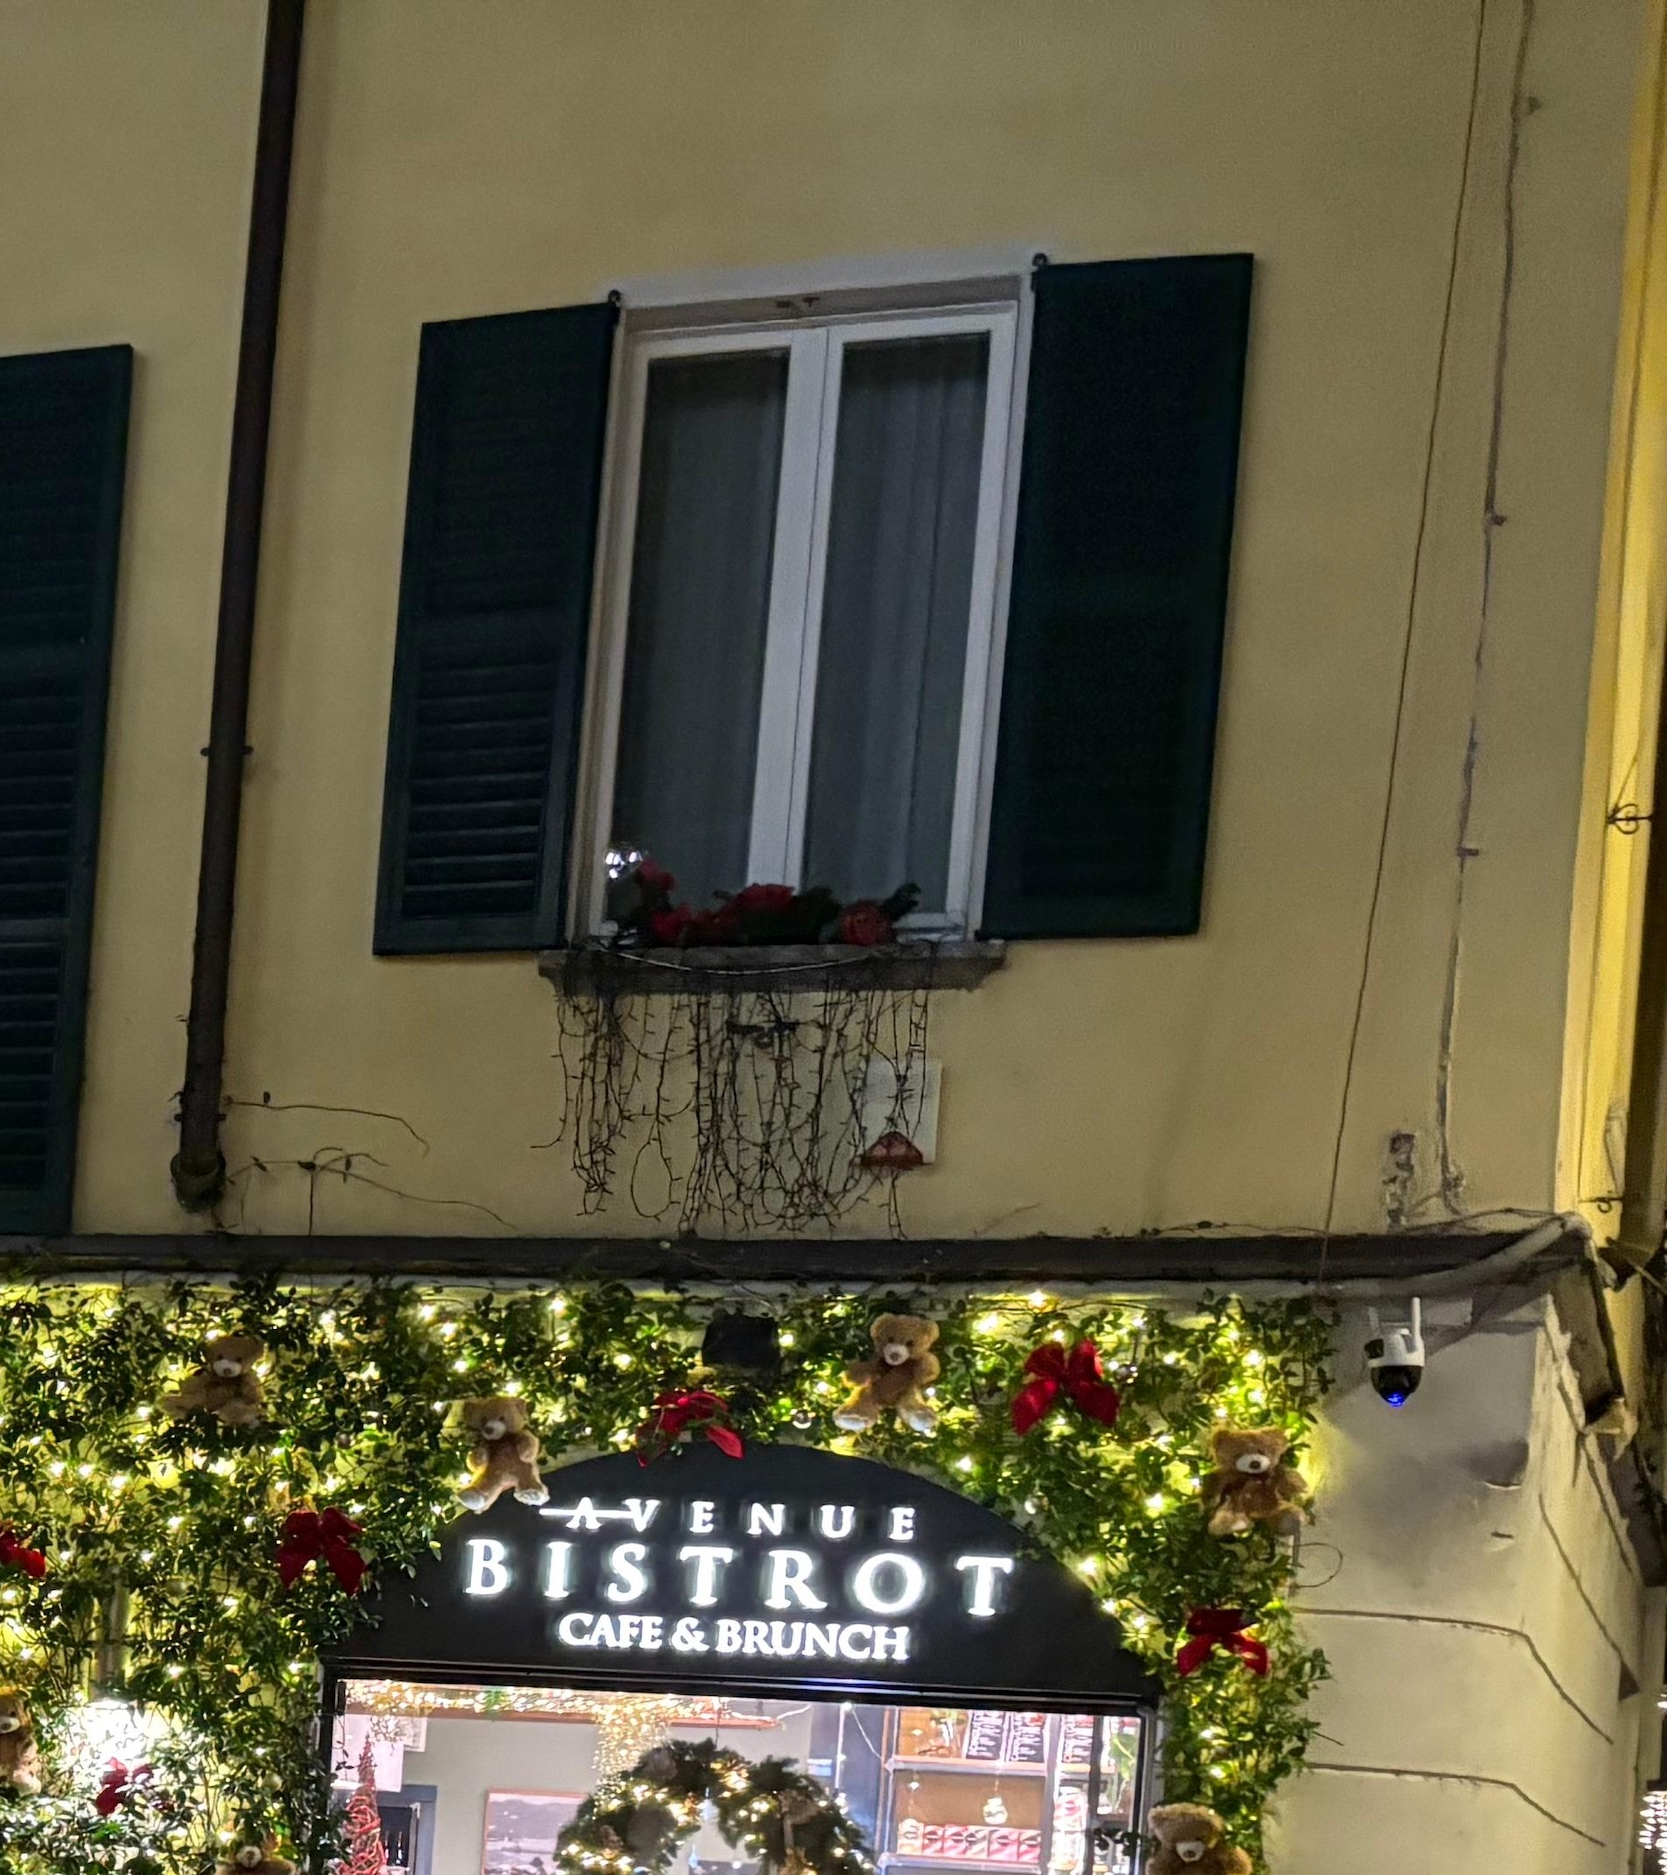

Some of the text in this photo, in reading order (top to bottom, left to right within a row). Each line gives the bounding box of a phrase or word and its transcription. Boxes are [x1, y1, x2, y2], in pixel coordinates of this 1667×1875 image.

[539, 1496, 915, 1541] AVENUE
[463, 1538, 1015, 1617] BISTROT
[558, 1612, 911, 1661] CAFE & BRUNCH
